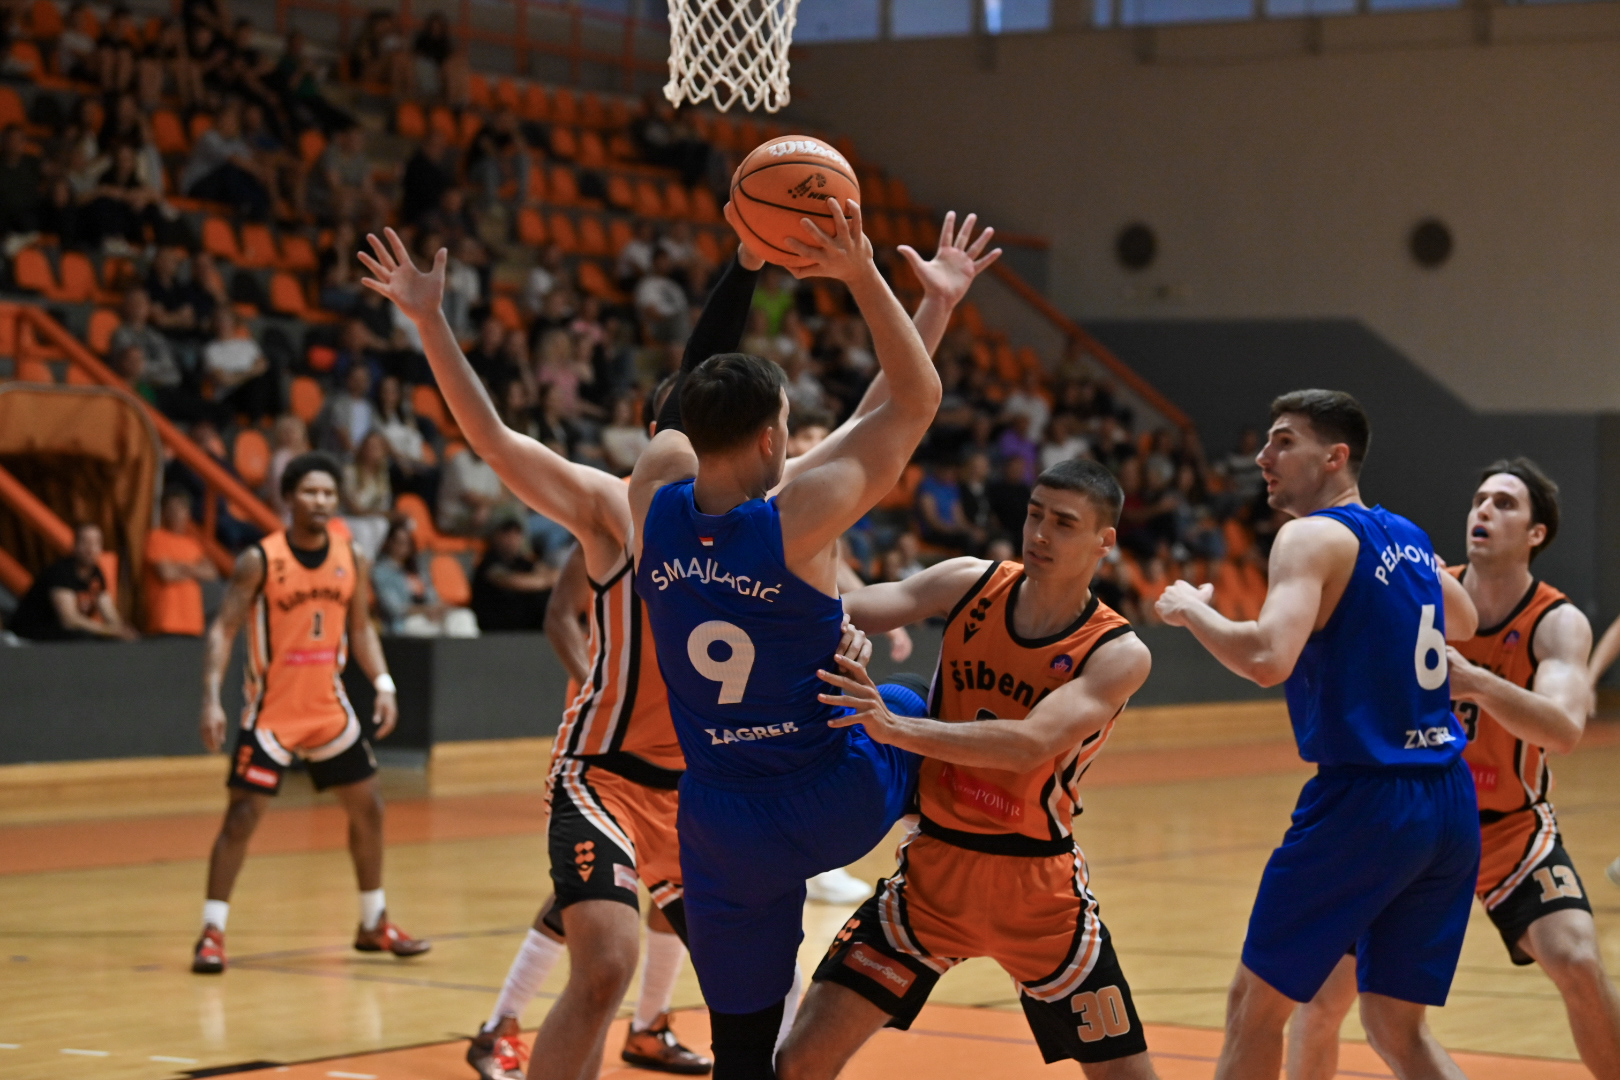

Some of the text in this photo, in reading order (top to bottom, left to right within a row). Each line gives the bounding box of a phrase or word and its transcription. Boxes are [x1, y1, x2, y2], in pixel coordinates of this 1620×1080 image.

[651, 557, 782, 603] SMAJLAGIĆ
[686, 619, 756, 705] 9
[1414, 604, 1448, 690] 6
[1532, 864, 1583, 904] 13
[851, 950, 909, 988] SuperSport
[1071, 984, 1131, 1043] 30
